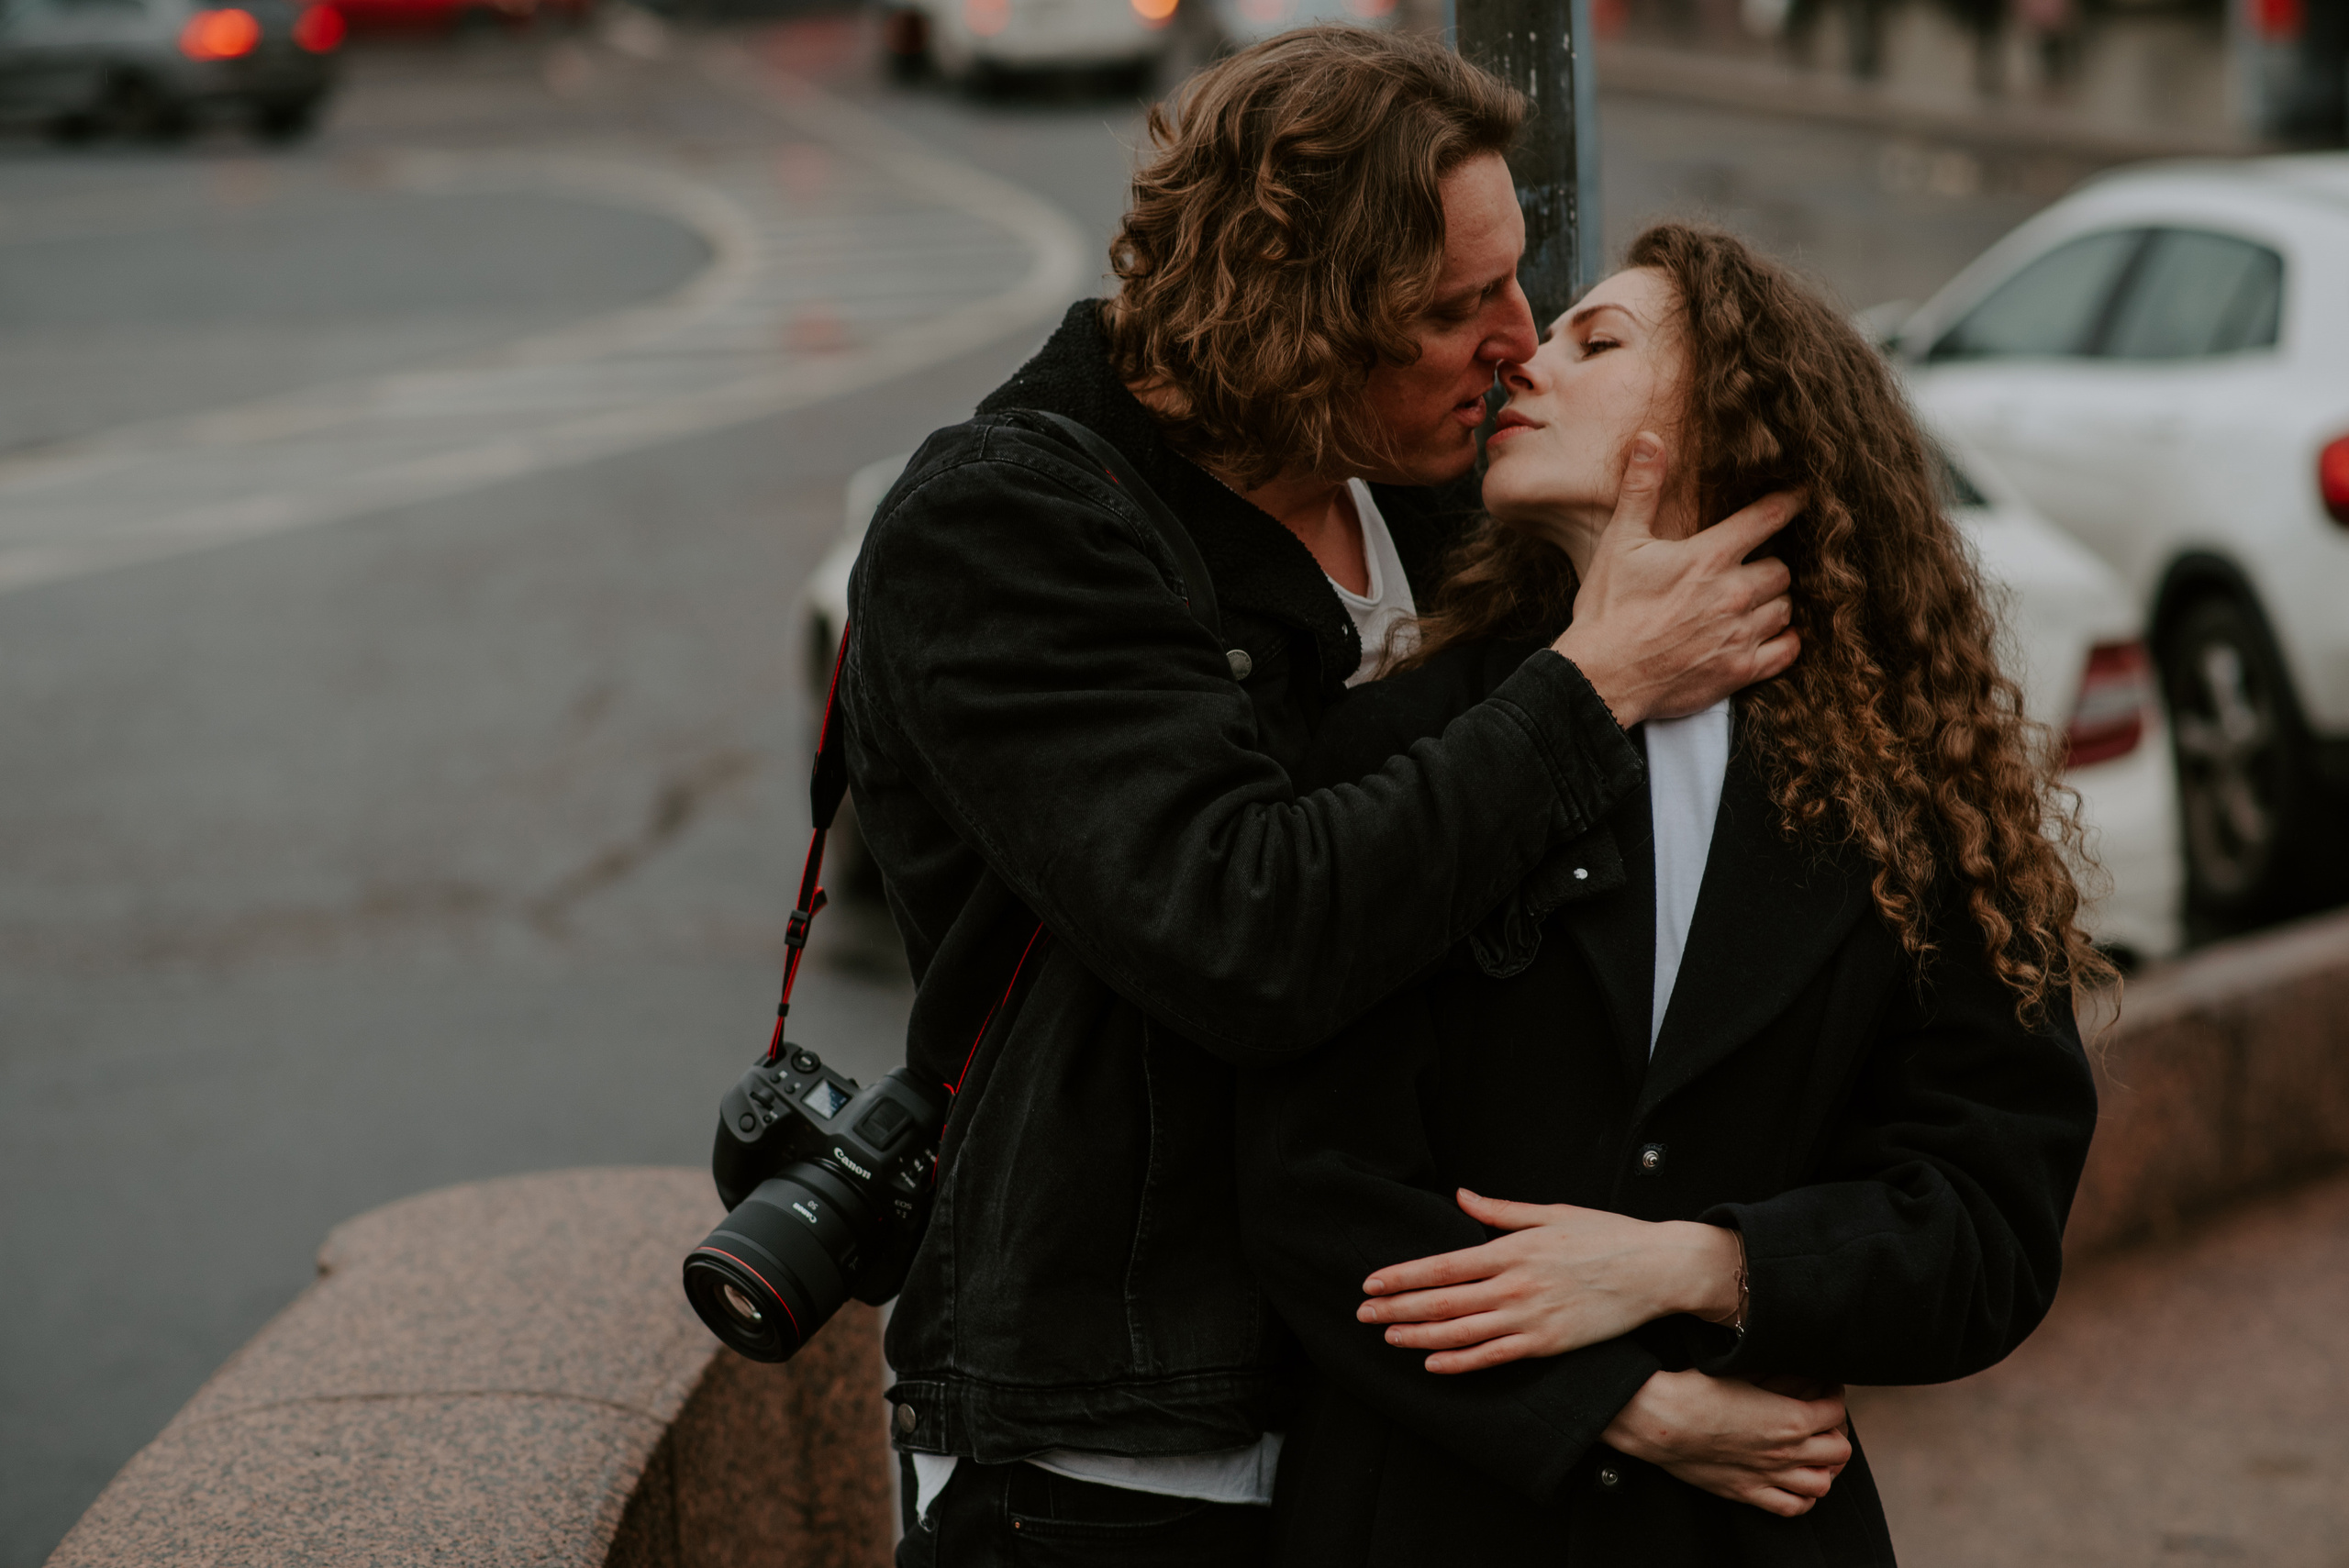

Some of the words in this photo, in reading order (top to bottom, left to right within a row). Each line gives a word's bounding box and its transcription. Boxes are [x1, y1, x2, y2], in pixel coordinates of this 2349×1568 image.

[833, 1147, 872, 1180] Canon
[807, 1200, 818, 1210] 50
[895, 1199, 912, 1210] EOS
[792, 1202, 818, 1224] Canon
